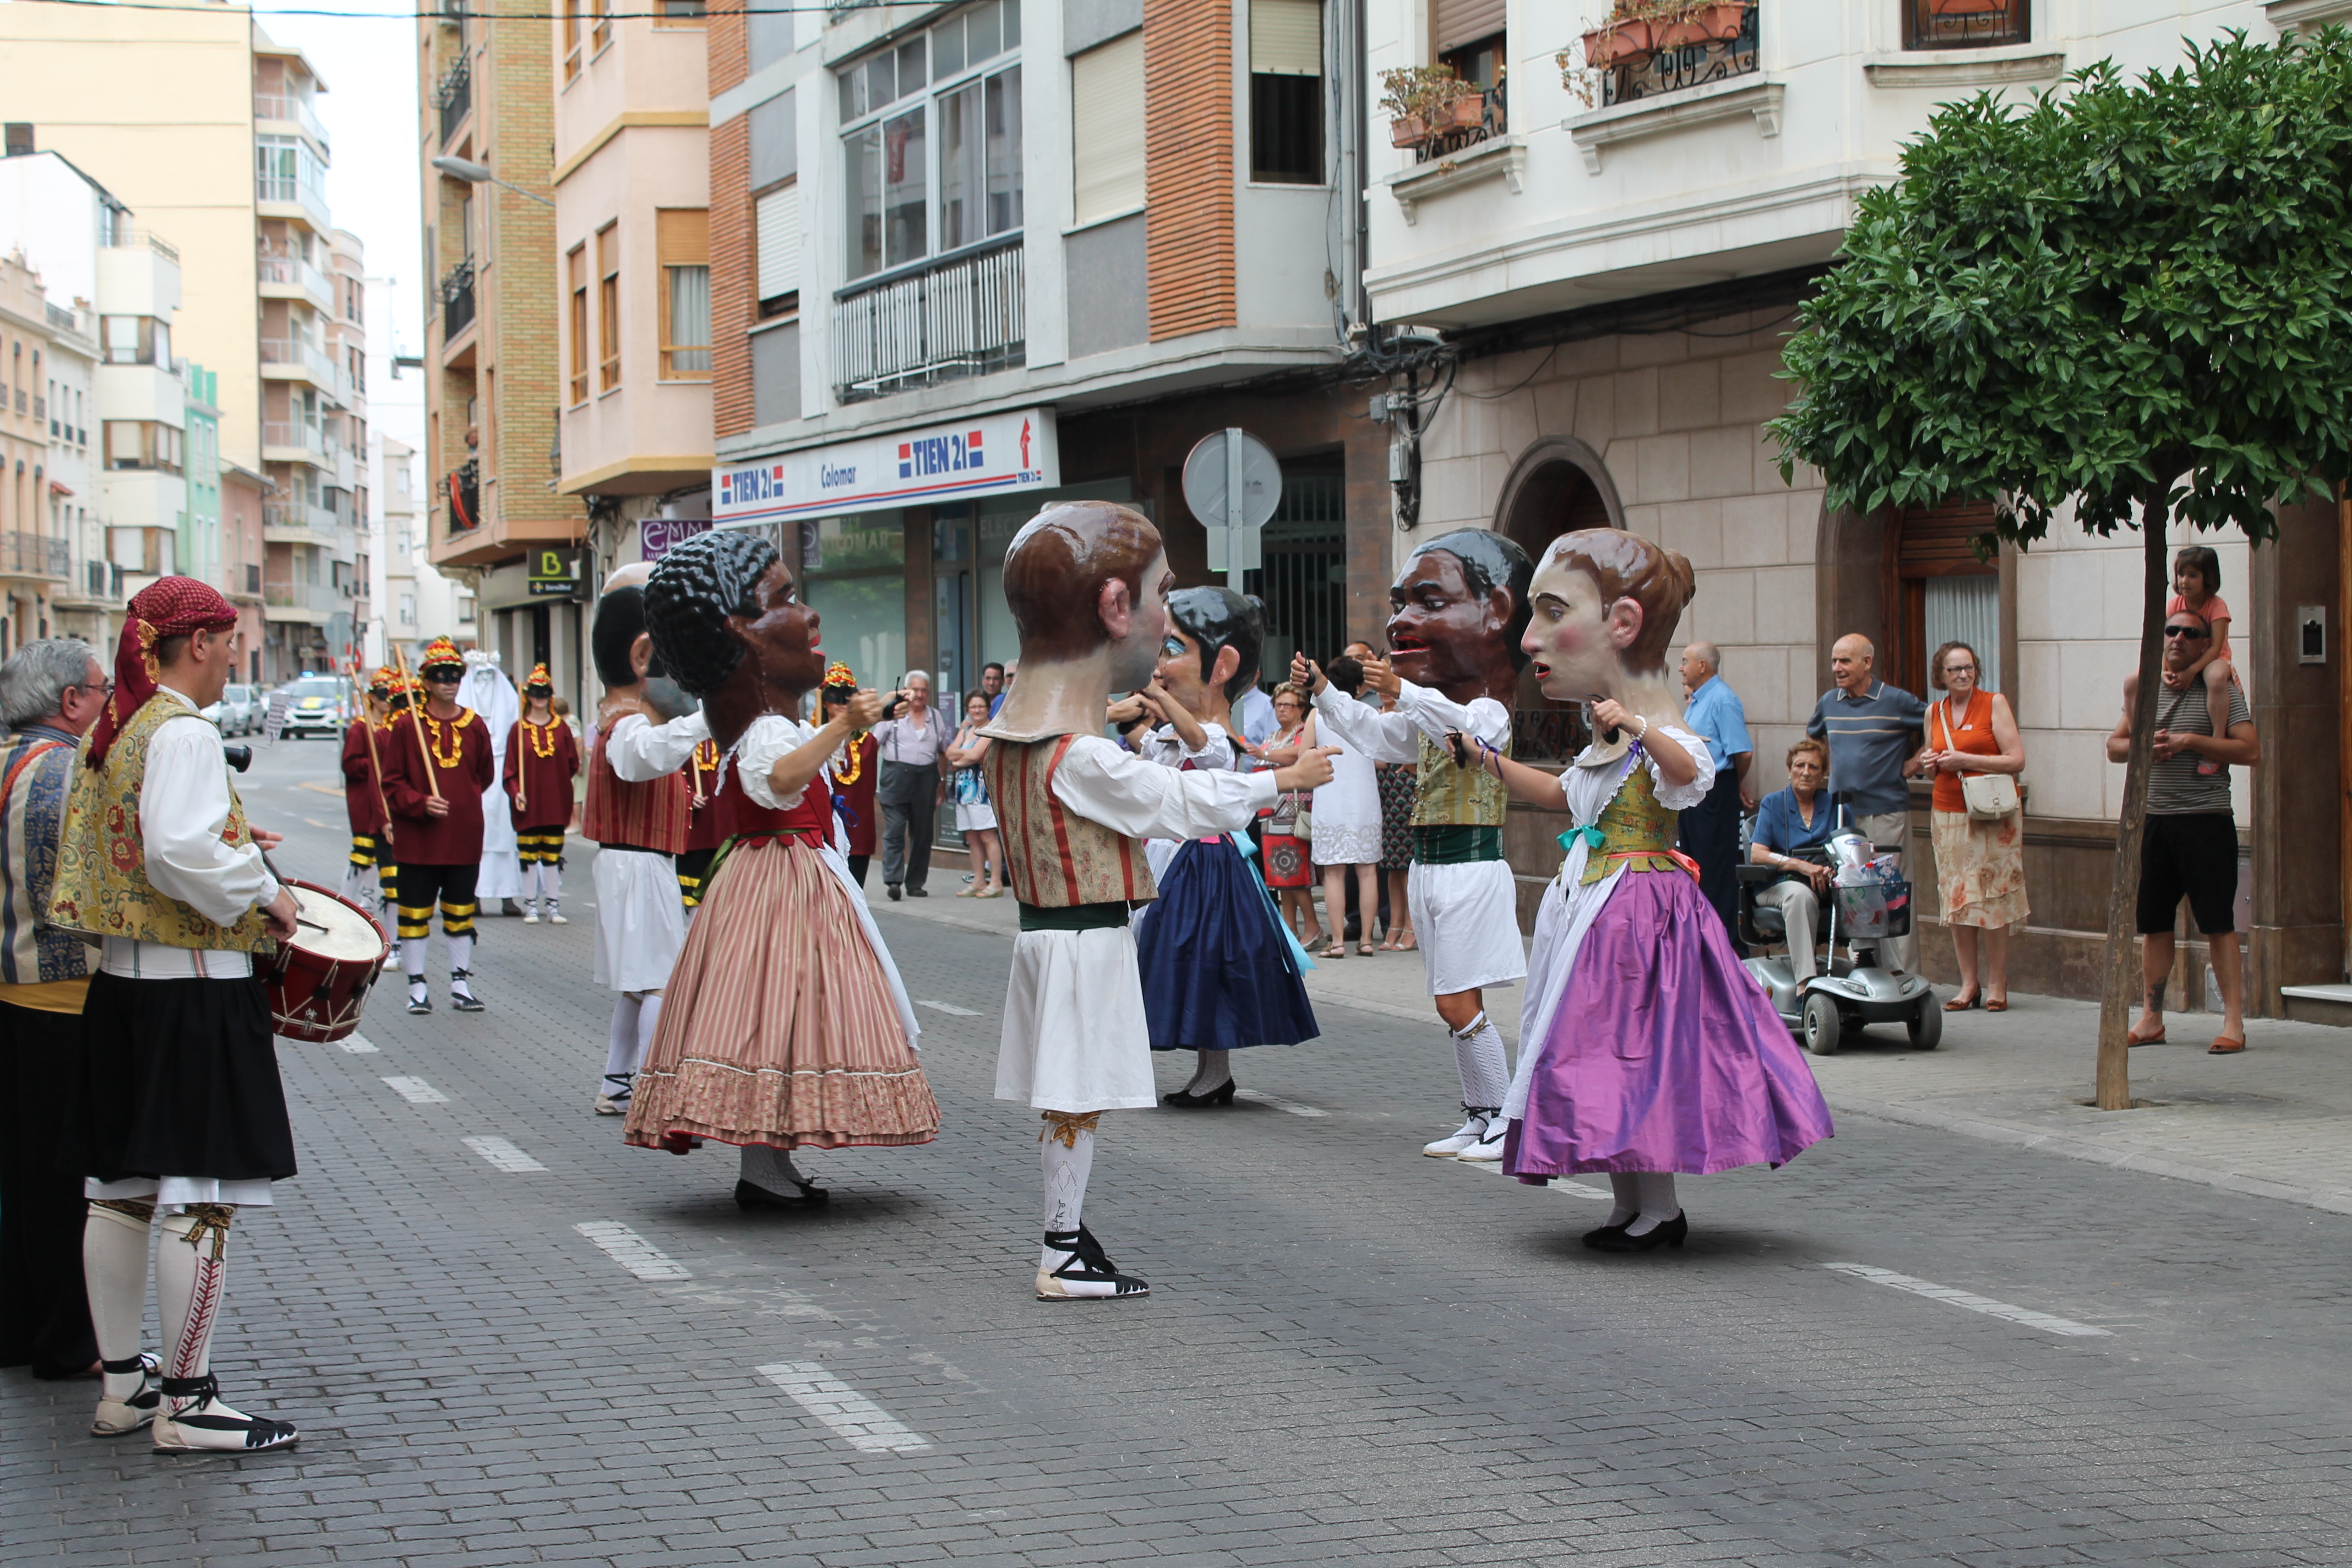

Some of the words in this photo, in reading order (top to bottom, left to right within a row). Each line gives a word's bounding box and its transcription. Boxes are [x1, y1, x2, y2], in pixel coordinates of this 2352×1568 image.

[913, 436, 949, 476] TIEN
[952, 433, 967, 471] 21
[732, 469, 759, 503] TIEN
[761, 468, 772, 499] 21
[821, 462, 856, 489] Colomar
[1018, 471, 1030, 483] TIEN
